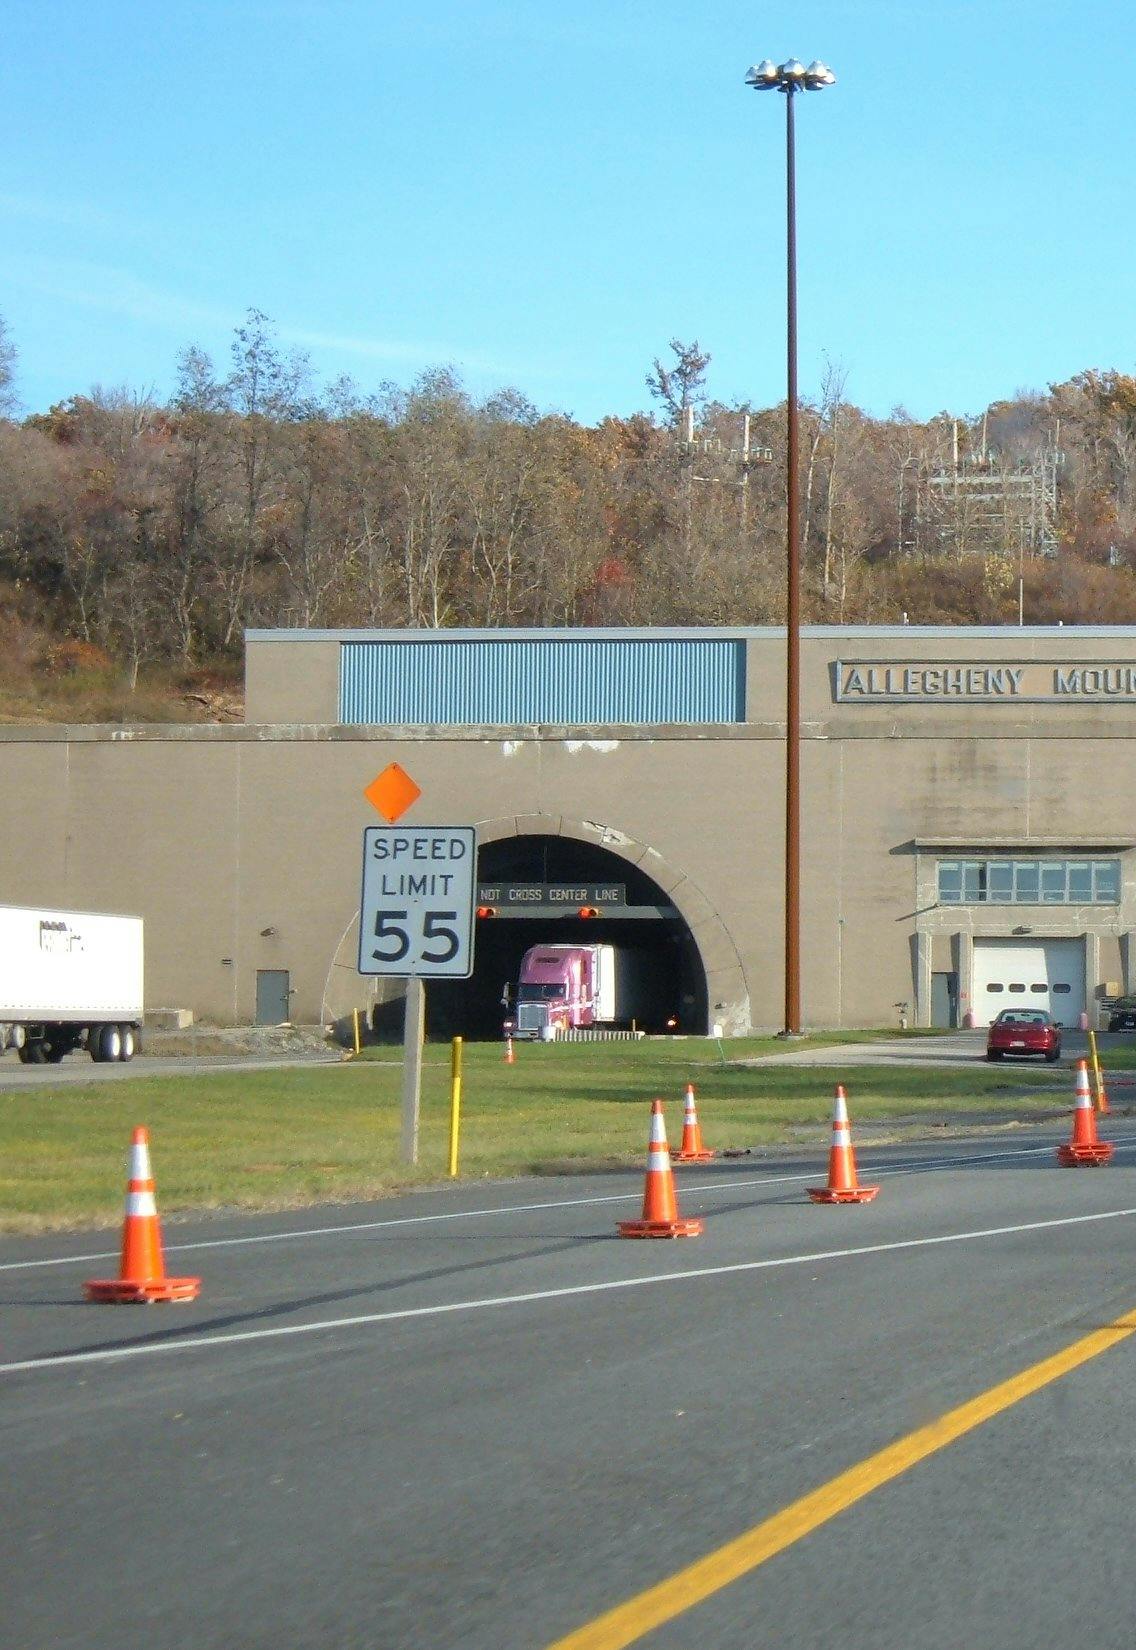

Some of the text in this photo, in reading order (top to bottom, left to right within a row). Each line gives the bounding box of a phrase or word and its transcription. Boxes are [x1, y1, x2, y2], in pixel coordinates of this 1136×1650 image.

[843, 668, 1022, 695] ALLEGHENY
[374, 838, 466, 860] SPEED
[382, 874, 454, 896] LIMIT
[480, 889, 619, 901] NOT CROSS CENTER LINE
[372, 910, 460, 963] 55
